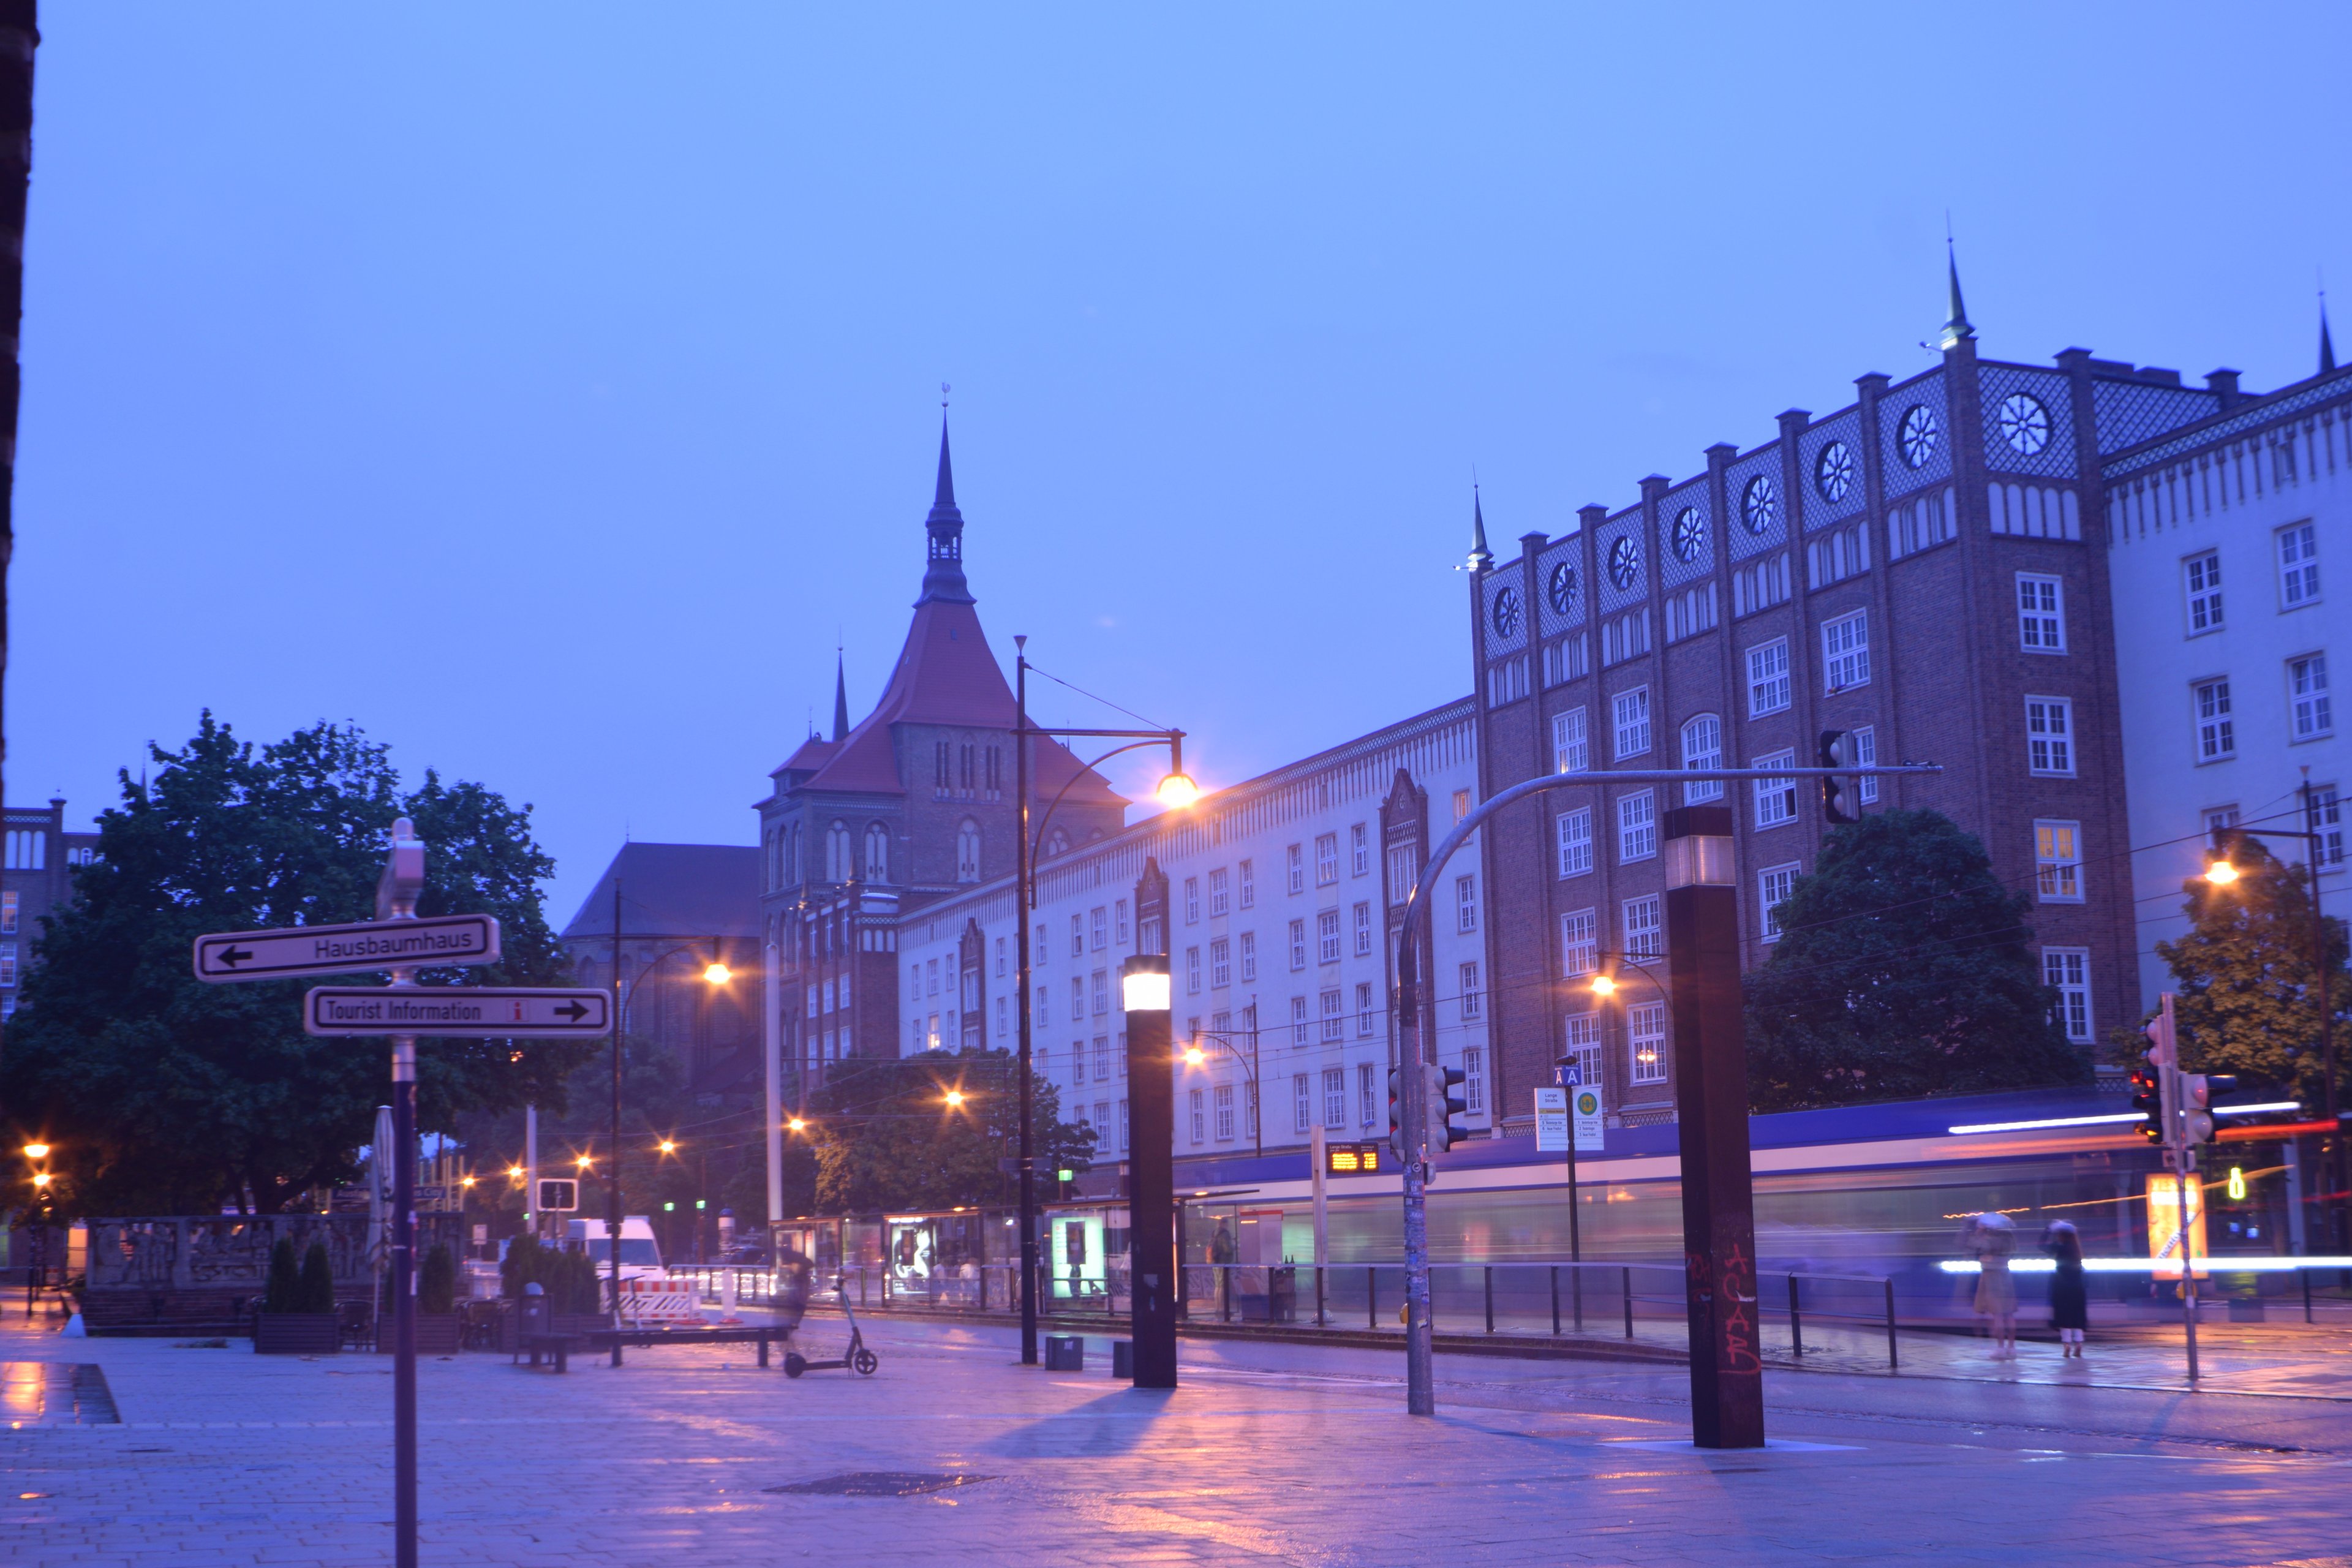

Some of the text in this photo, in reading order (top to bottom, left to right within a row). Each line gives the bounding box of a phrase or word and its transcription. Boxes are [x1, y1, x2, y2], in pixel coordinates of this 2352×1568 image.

[315, 932, 472, 959] Hausbaumhaus
[326, 1000, 382, 1020] Tourist
[388, 1000, 481, 1020] Information
[1556, 1071, 1562, 1084] A
[1567, 1070, 1578, 1084] A
